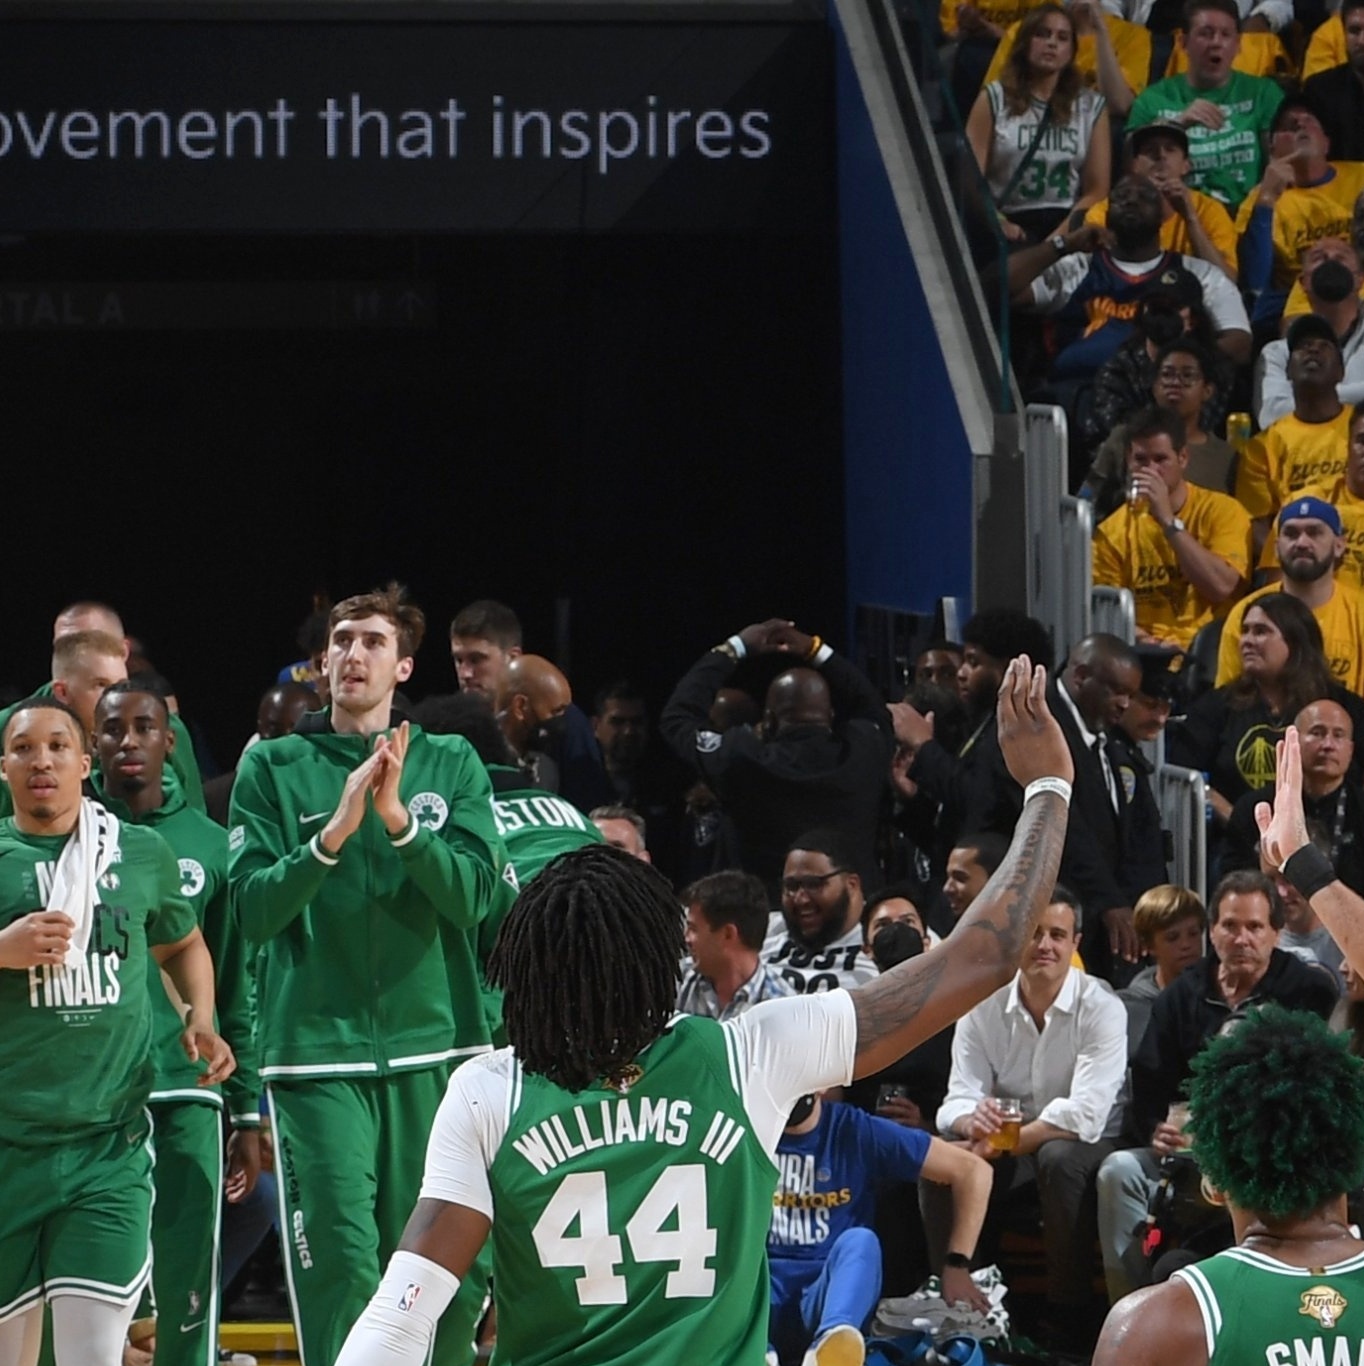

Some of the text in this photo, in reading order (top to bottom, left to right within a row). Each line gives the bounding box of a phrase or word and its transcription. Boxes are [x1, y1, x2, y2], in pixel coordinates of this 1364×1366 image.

[0, 93, 771, 173] vement that inspires
[1019, 160, 1071, 199] 34
[97, 290, 125, 326] A
[29, 953, 121, 1007] FINALS
[767, 940, 863, 971] JUST
[511, 1096, 746, 1176] WILLIAMS III
[293, 1209, 314, 1270] CELTICS
[531, 1163, 718, 1306] 44
[1302, 1292, 1345, 1312] Finals
